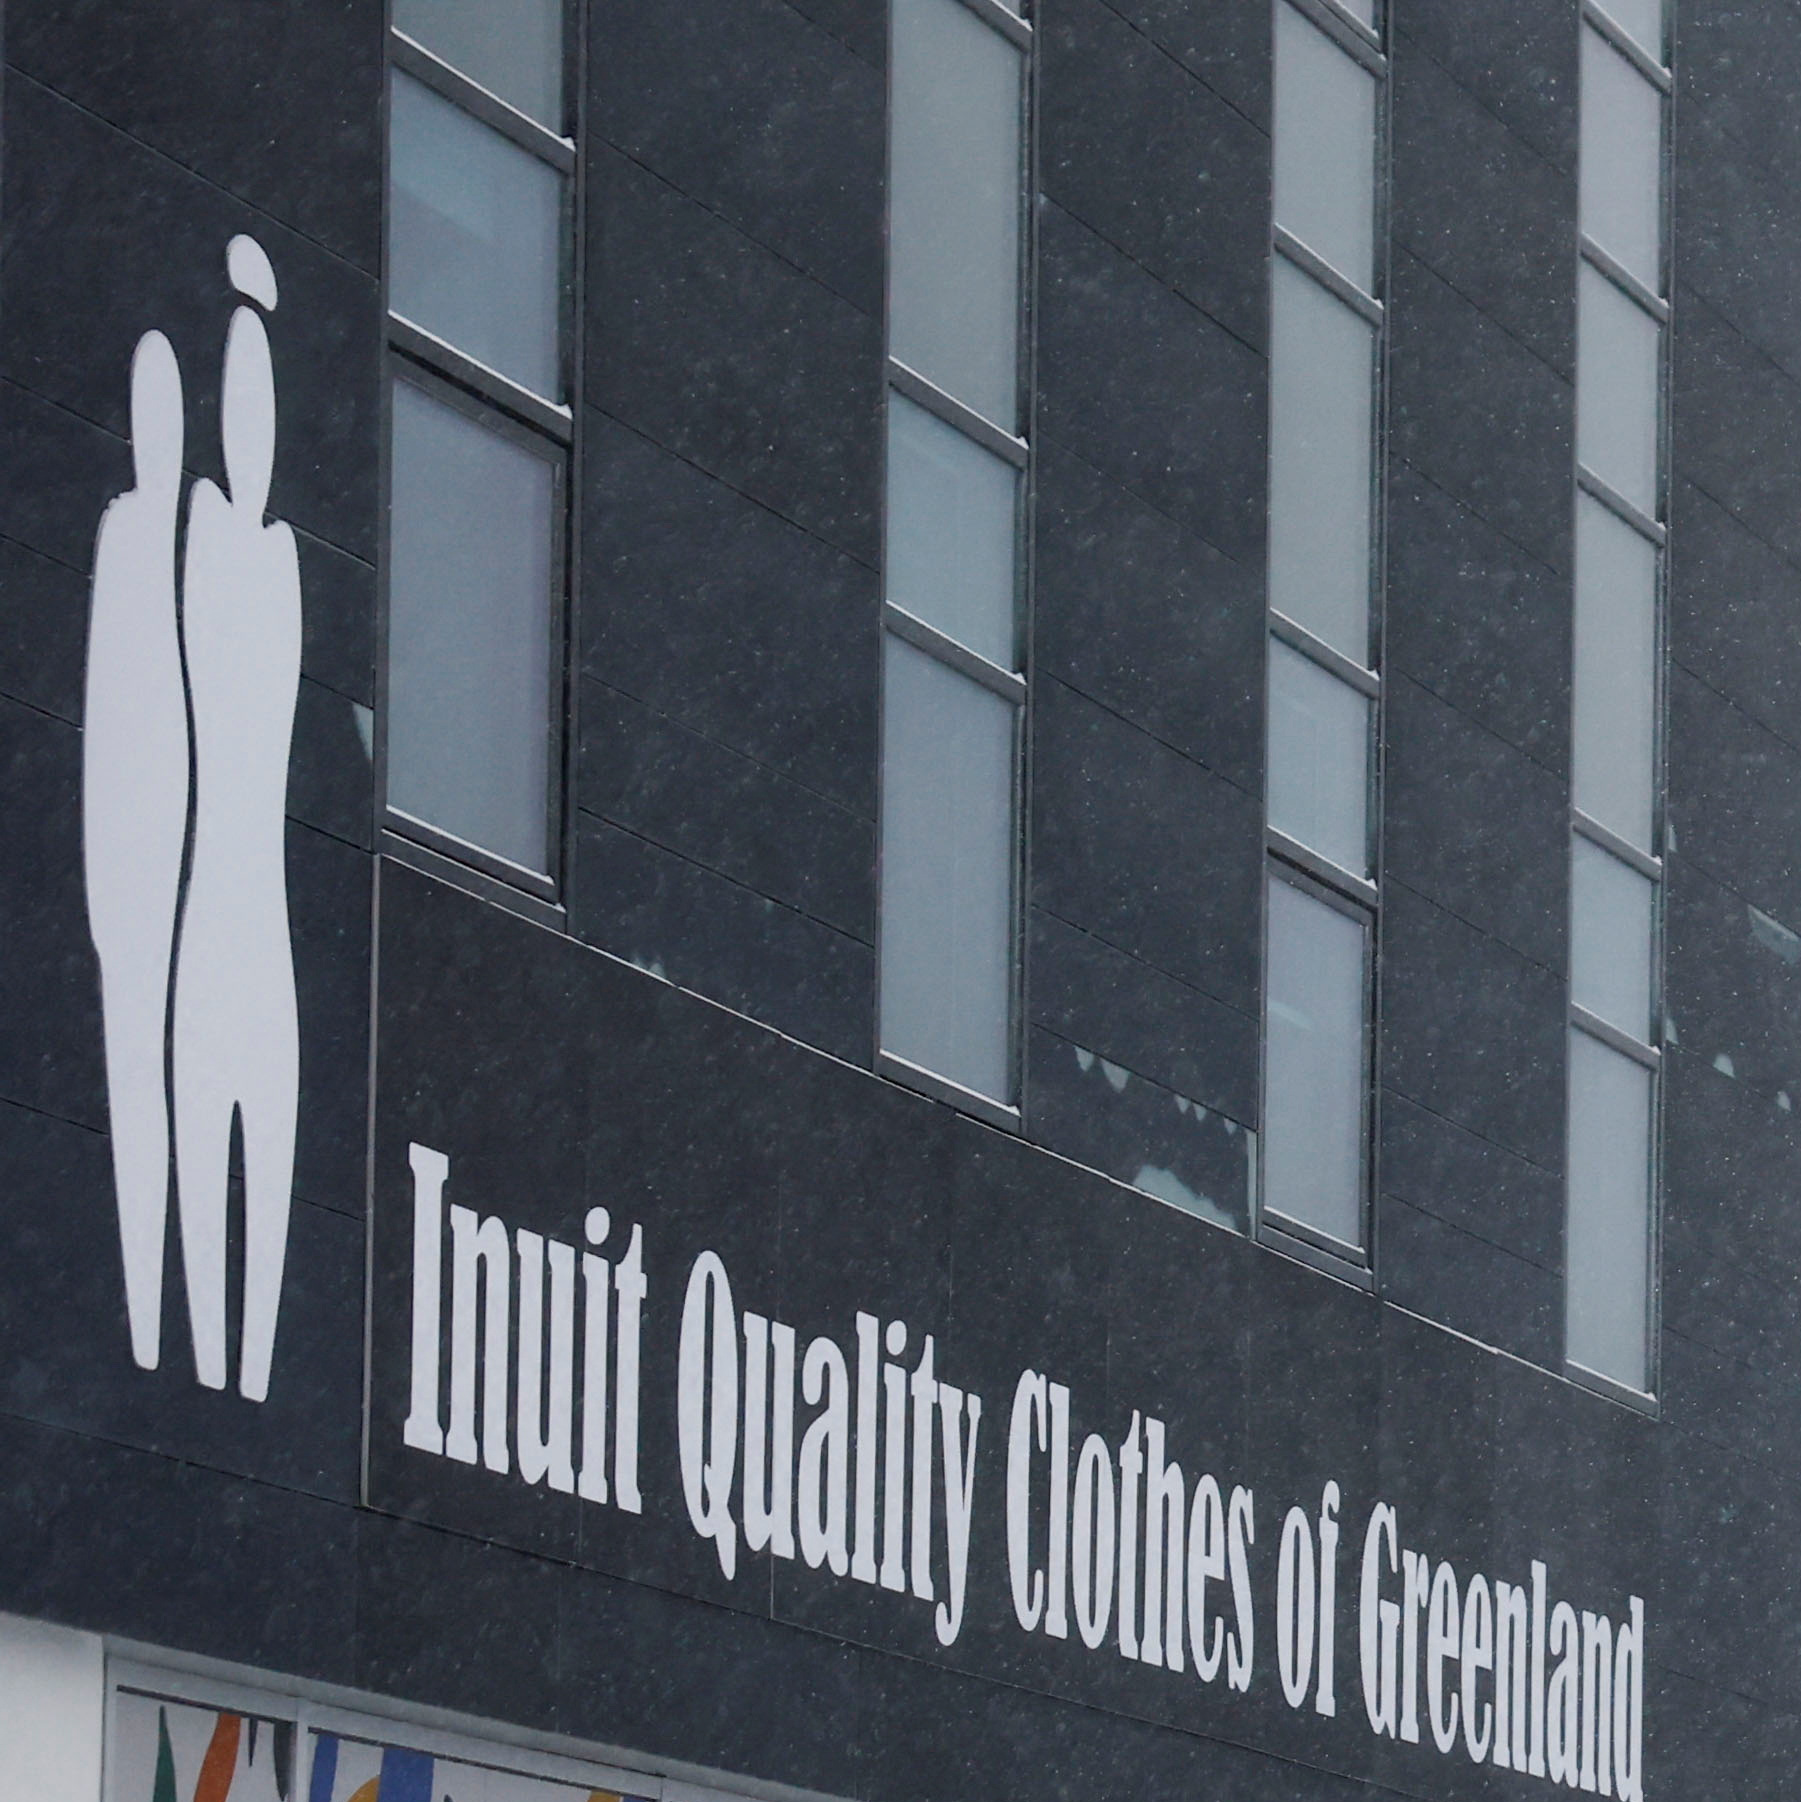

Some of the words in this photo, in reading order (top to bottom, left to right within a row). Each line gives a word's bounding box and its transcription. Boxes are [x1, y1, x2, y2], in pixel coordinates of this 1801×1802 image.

[404, 1143, 647, 1515] Inuit
[679, 1250, 982, 1646] Quality
[1006, 1369, 1255, 1693] Clothes
[1276, 1480, 1340, 1717] of
